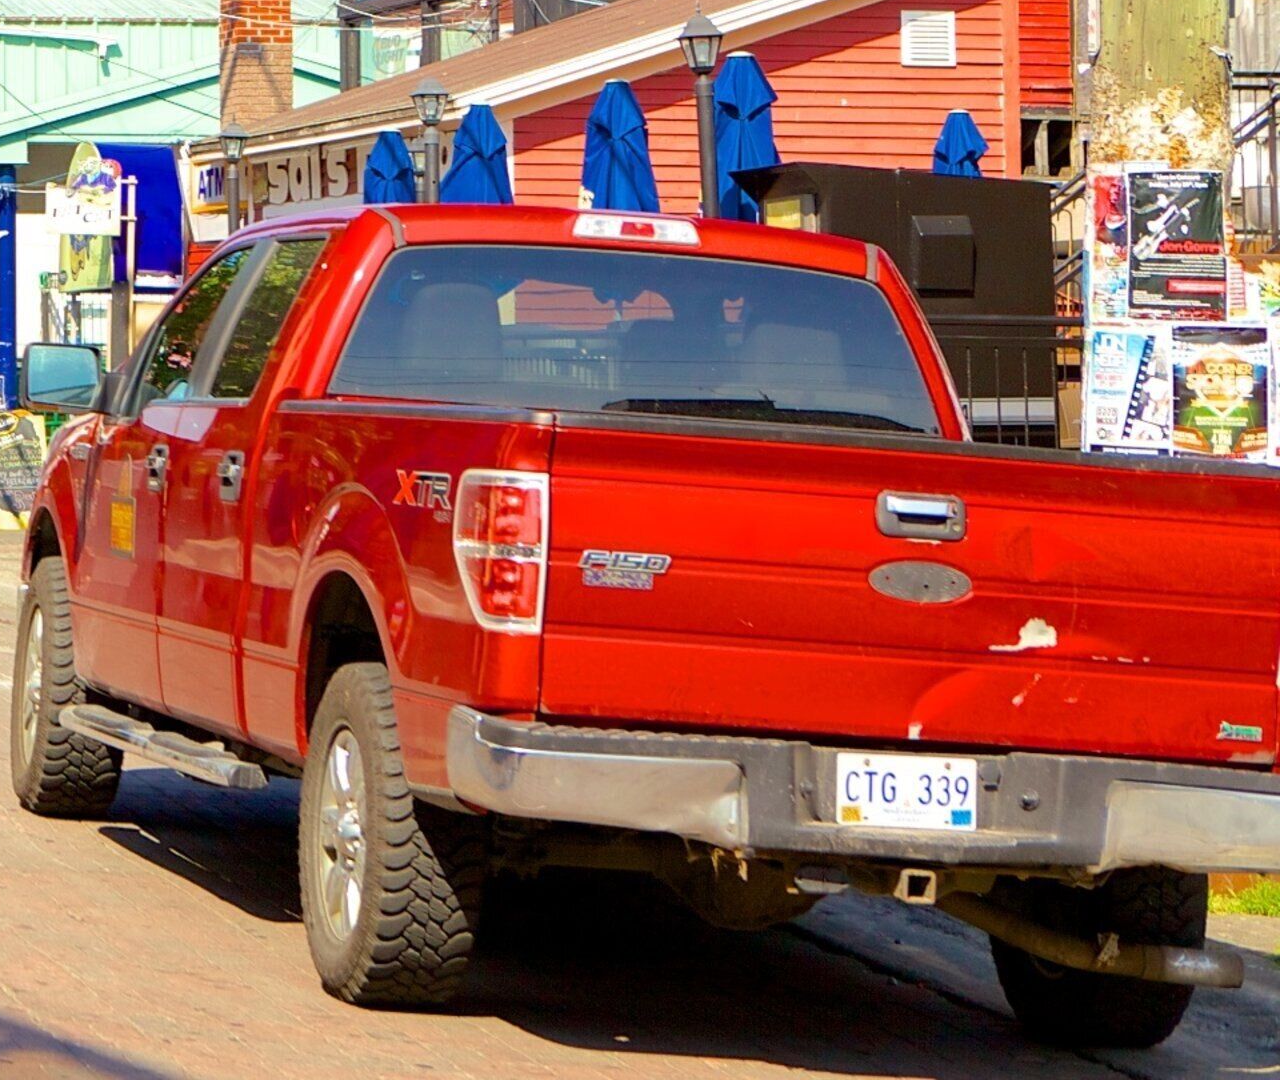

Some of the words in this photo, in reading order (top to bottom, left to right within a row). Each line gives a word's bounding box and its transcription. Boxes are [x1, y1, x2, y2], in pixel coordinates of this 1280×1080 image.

[392, 469, 453, 511] XTR
[845, 771, 897, 803] CTG
[918, 774, 970, 806] 339
